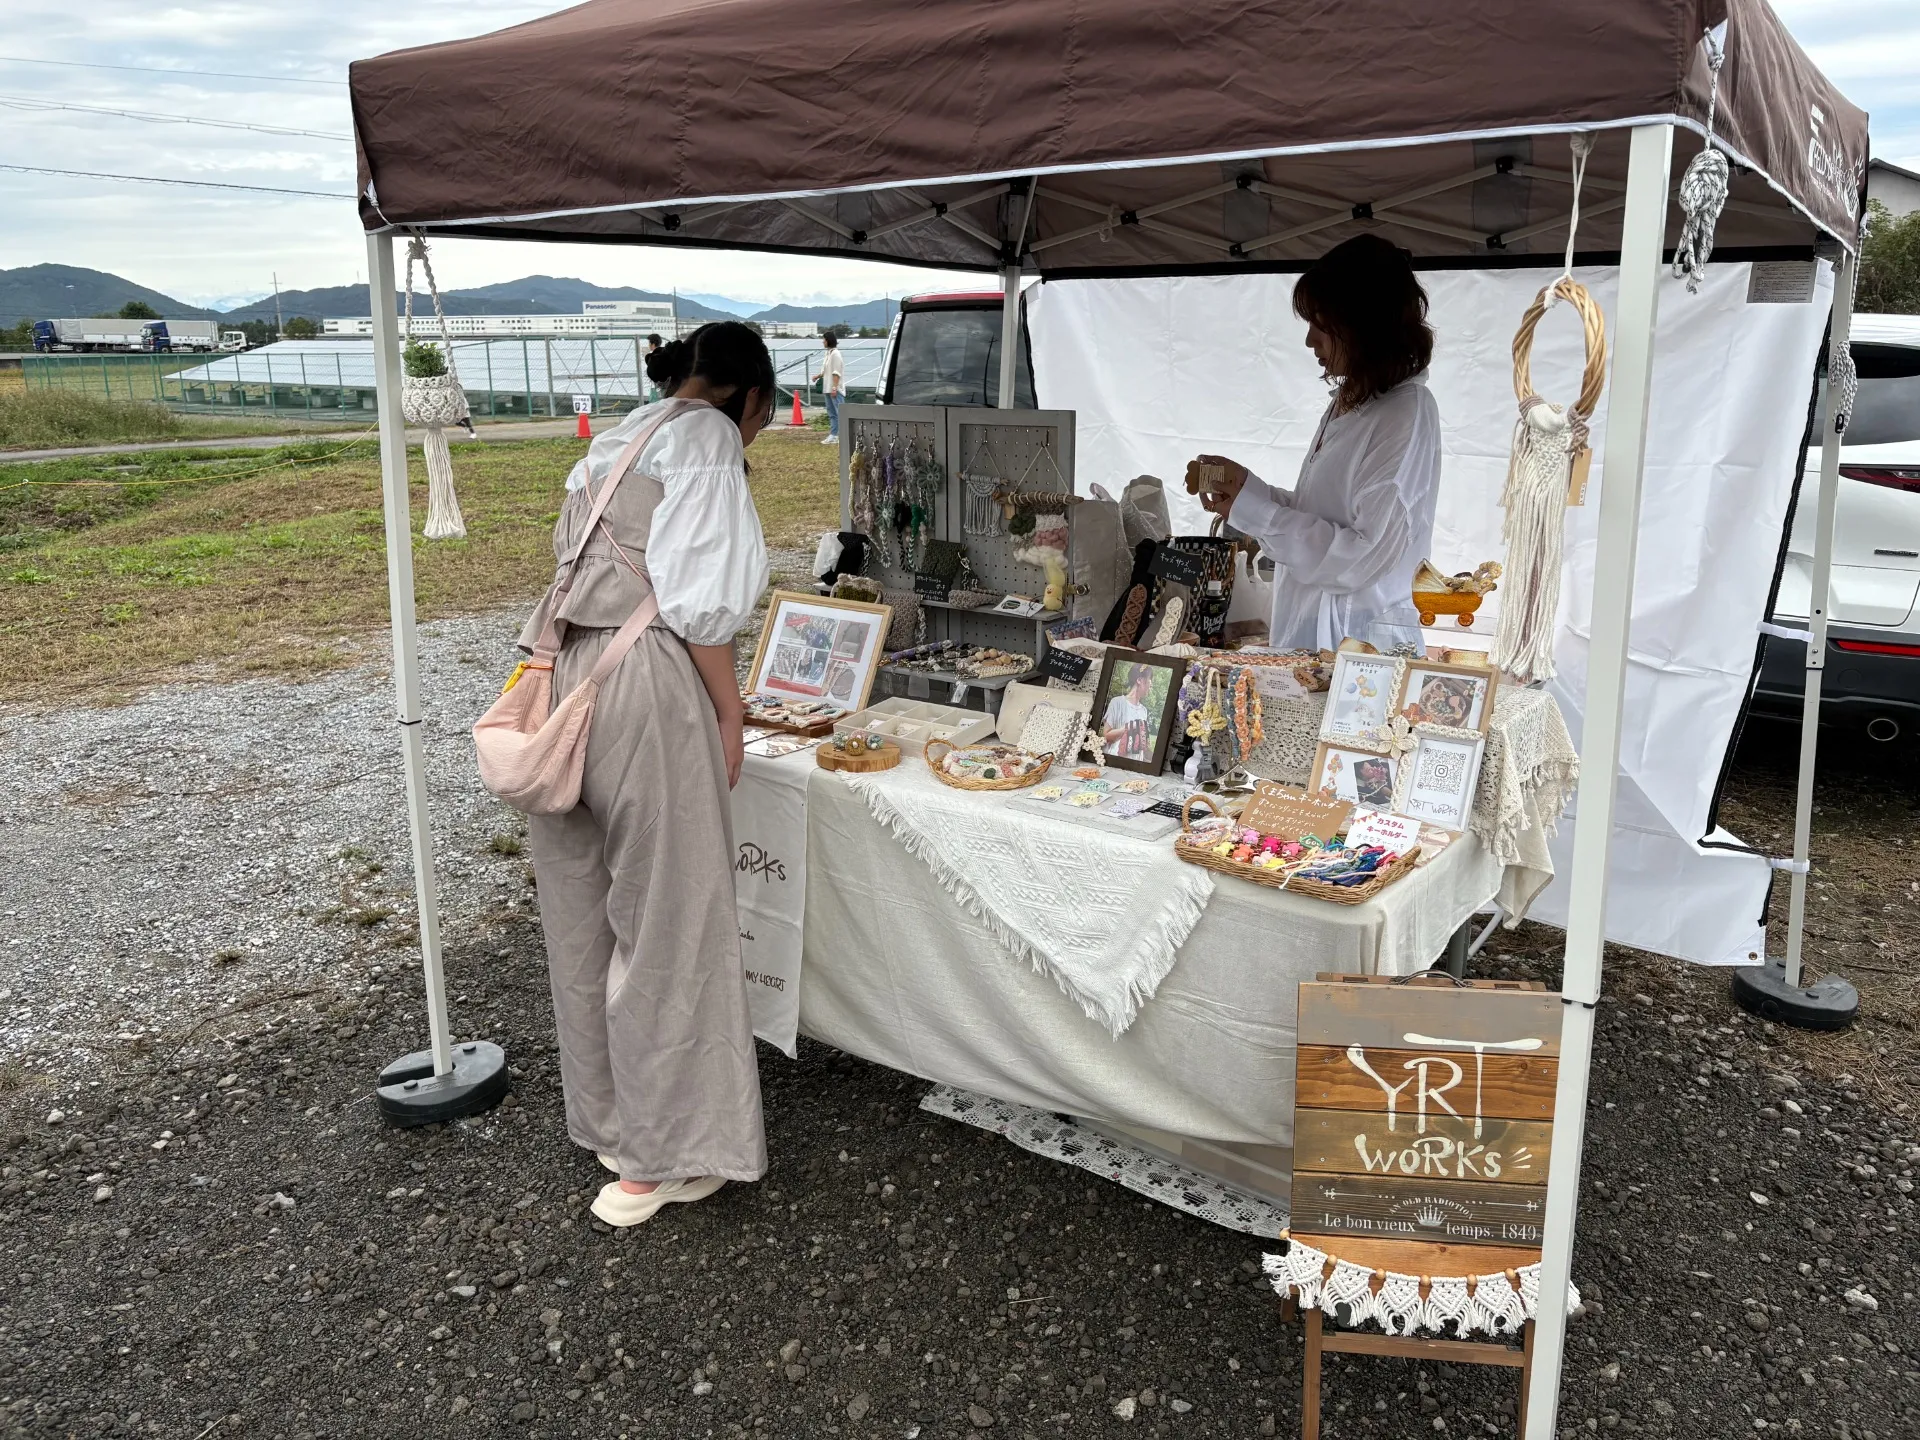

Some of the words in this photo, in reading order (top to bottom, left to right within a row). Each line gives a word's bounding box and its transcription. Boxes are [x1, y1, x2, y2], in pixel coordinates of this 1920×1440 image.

[1261, 784, 1297, 802] くまちゃん
[1298, 793, 1341, 810] キーホルダー
[1376, 817, 1405, 830] カスタム
[1367, 826, 1408, 839] キーホルダー
[745, 969, 758, 984] MY
[1346, 1032, 1543, 1139] YRT
[1402, 1197, 1422, 1206] OLD
[1324, 1213, 1342, 1228] Le
[1346, 1214, 1372, 1230] bon
[1376, 1218, 1416, 1233] vieux
[1446, 1223, 1495, 1239] temps.
[1501, 1223, 1537, 1241] 1849
